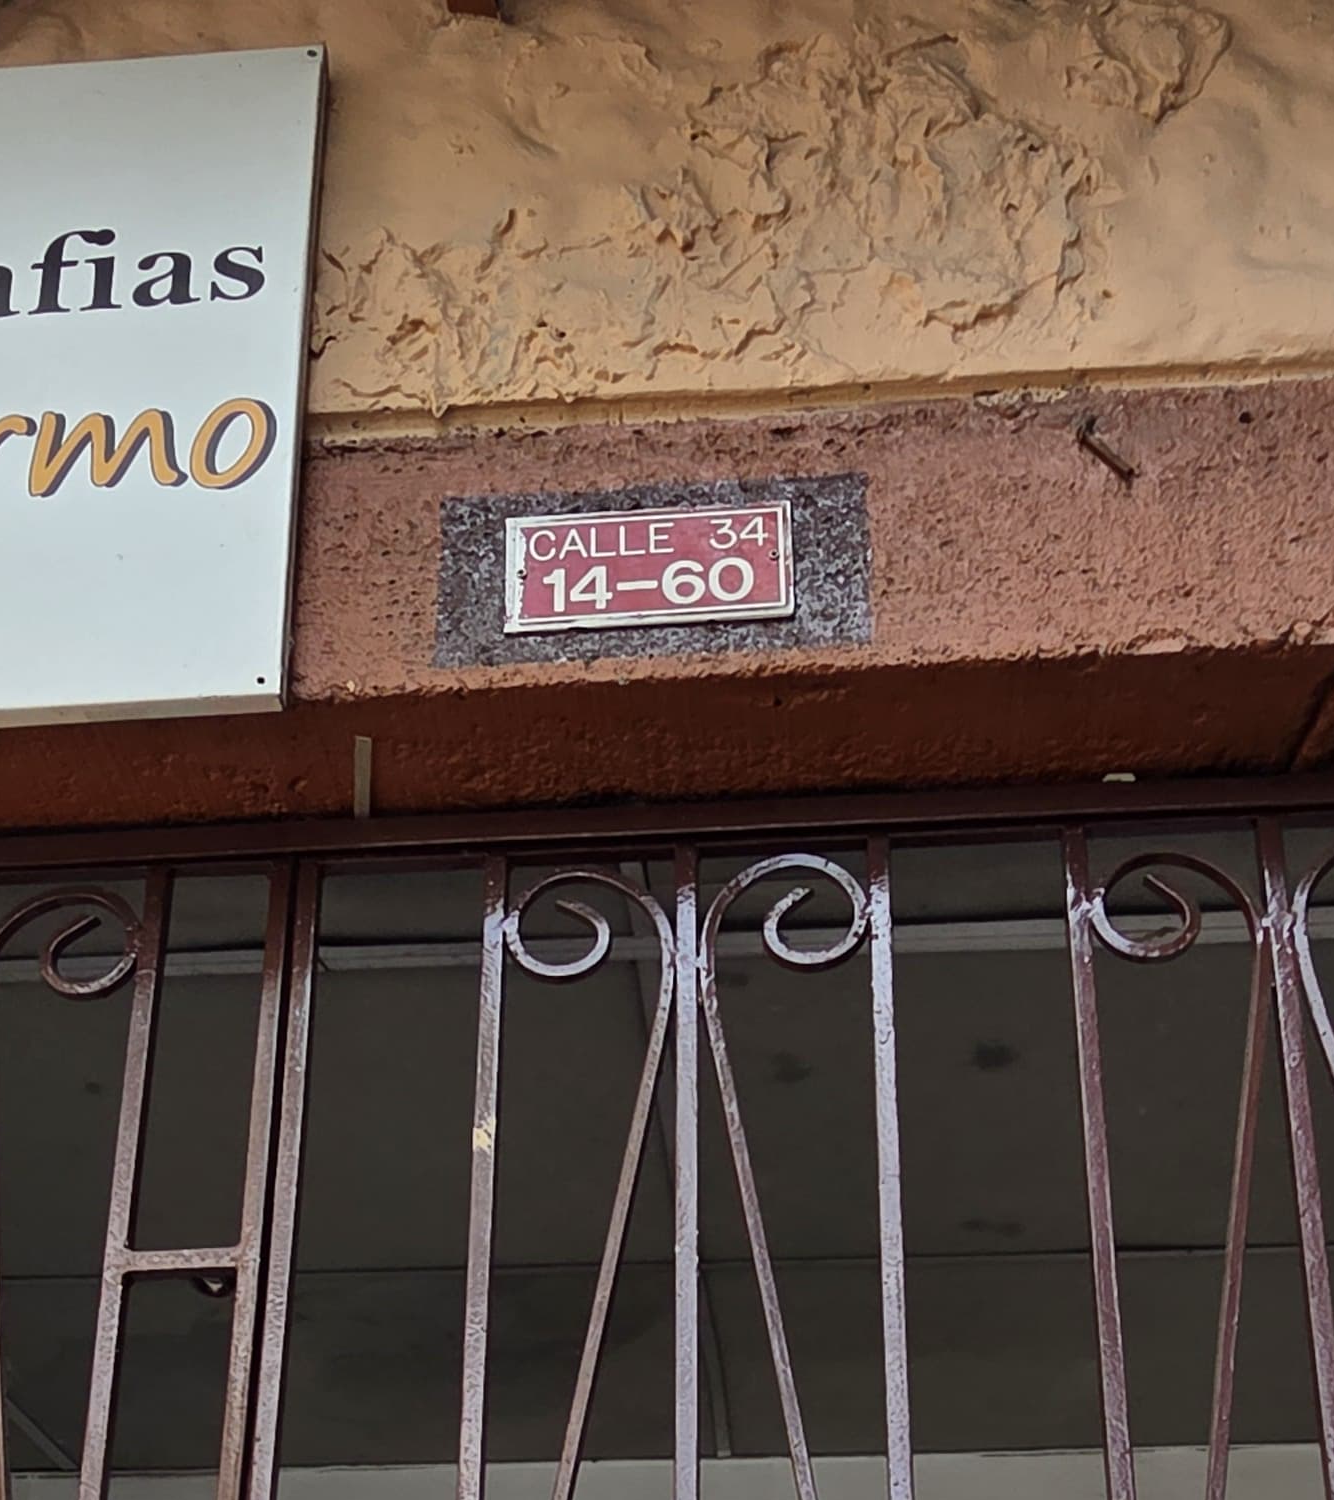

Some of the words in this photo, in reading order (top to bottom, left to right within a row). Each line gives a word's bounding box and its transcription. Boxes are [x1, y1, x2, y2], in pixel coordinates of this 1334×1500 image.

[528, 521, 675, 561] CALLE
[708, 516, 769, 550] 34
[542, 556, 755, 613] 14-60
